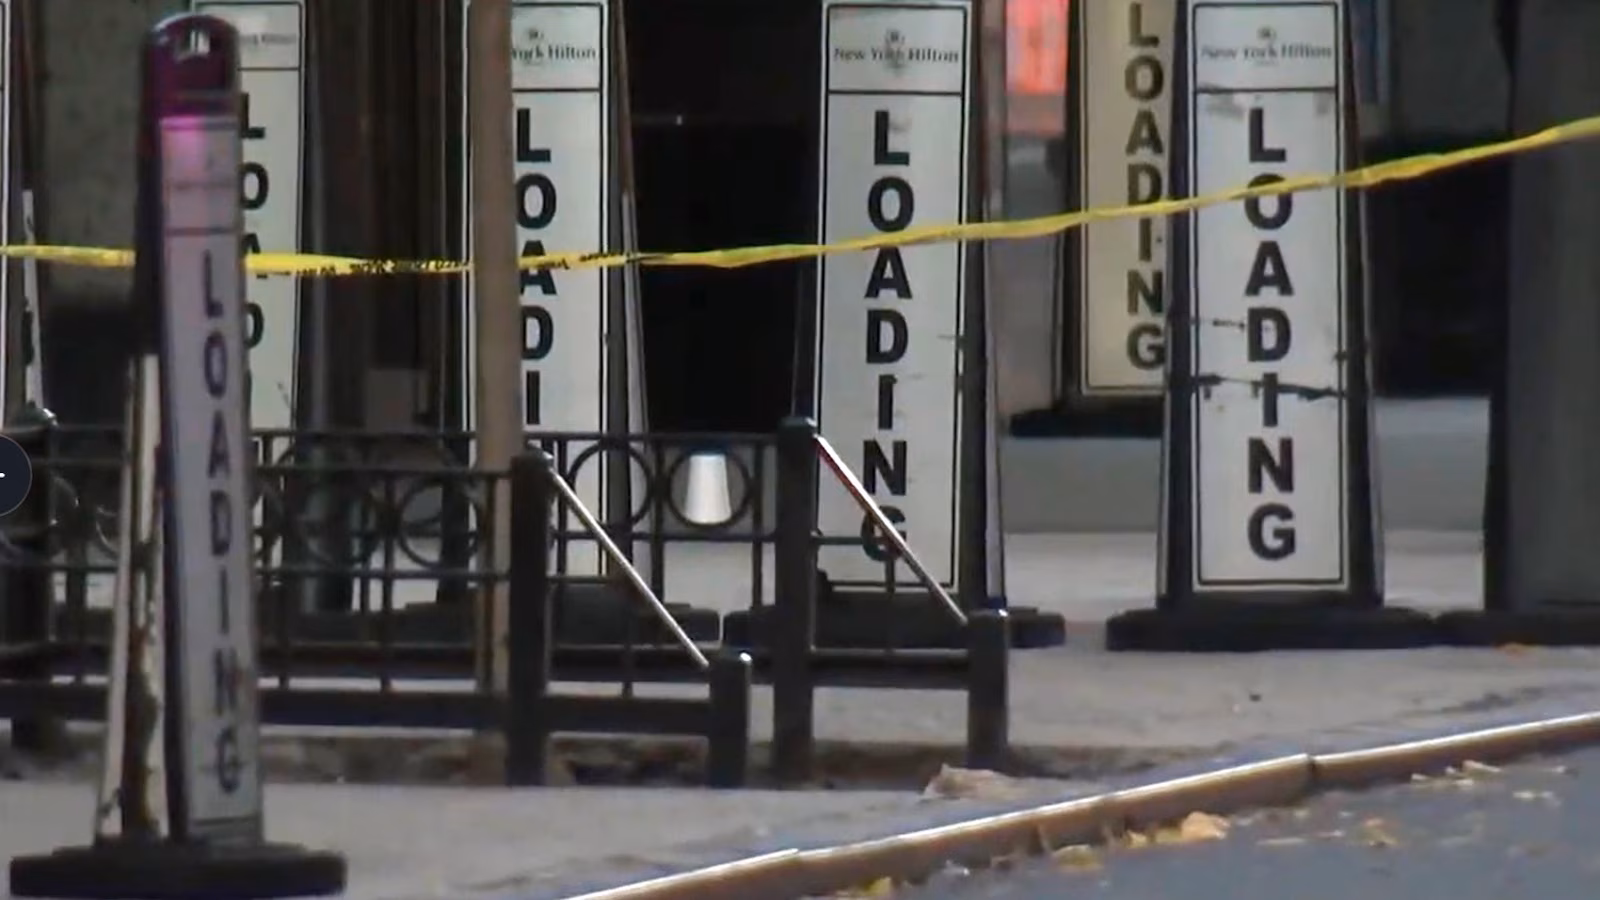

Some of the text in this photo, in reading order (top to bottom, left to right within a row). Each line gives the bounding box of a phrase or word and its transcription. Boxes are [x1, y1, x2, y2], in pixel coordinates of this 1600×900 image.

[548, 45, 597, 60] Hilton
[833, 48, 865, 62] New
[908, 48, 959, 63] Hilton
[1125, 2, 1165, 371] LOADING
[1281, 44, 1332, 59] Hilton
[516, 108, 557, 428] LOADI
[860, 109, 915, 563] LOADING
[1244, 107, 1297, 561] LOADING
[203, 250, 241, 794] LOADING
